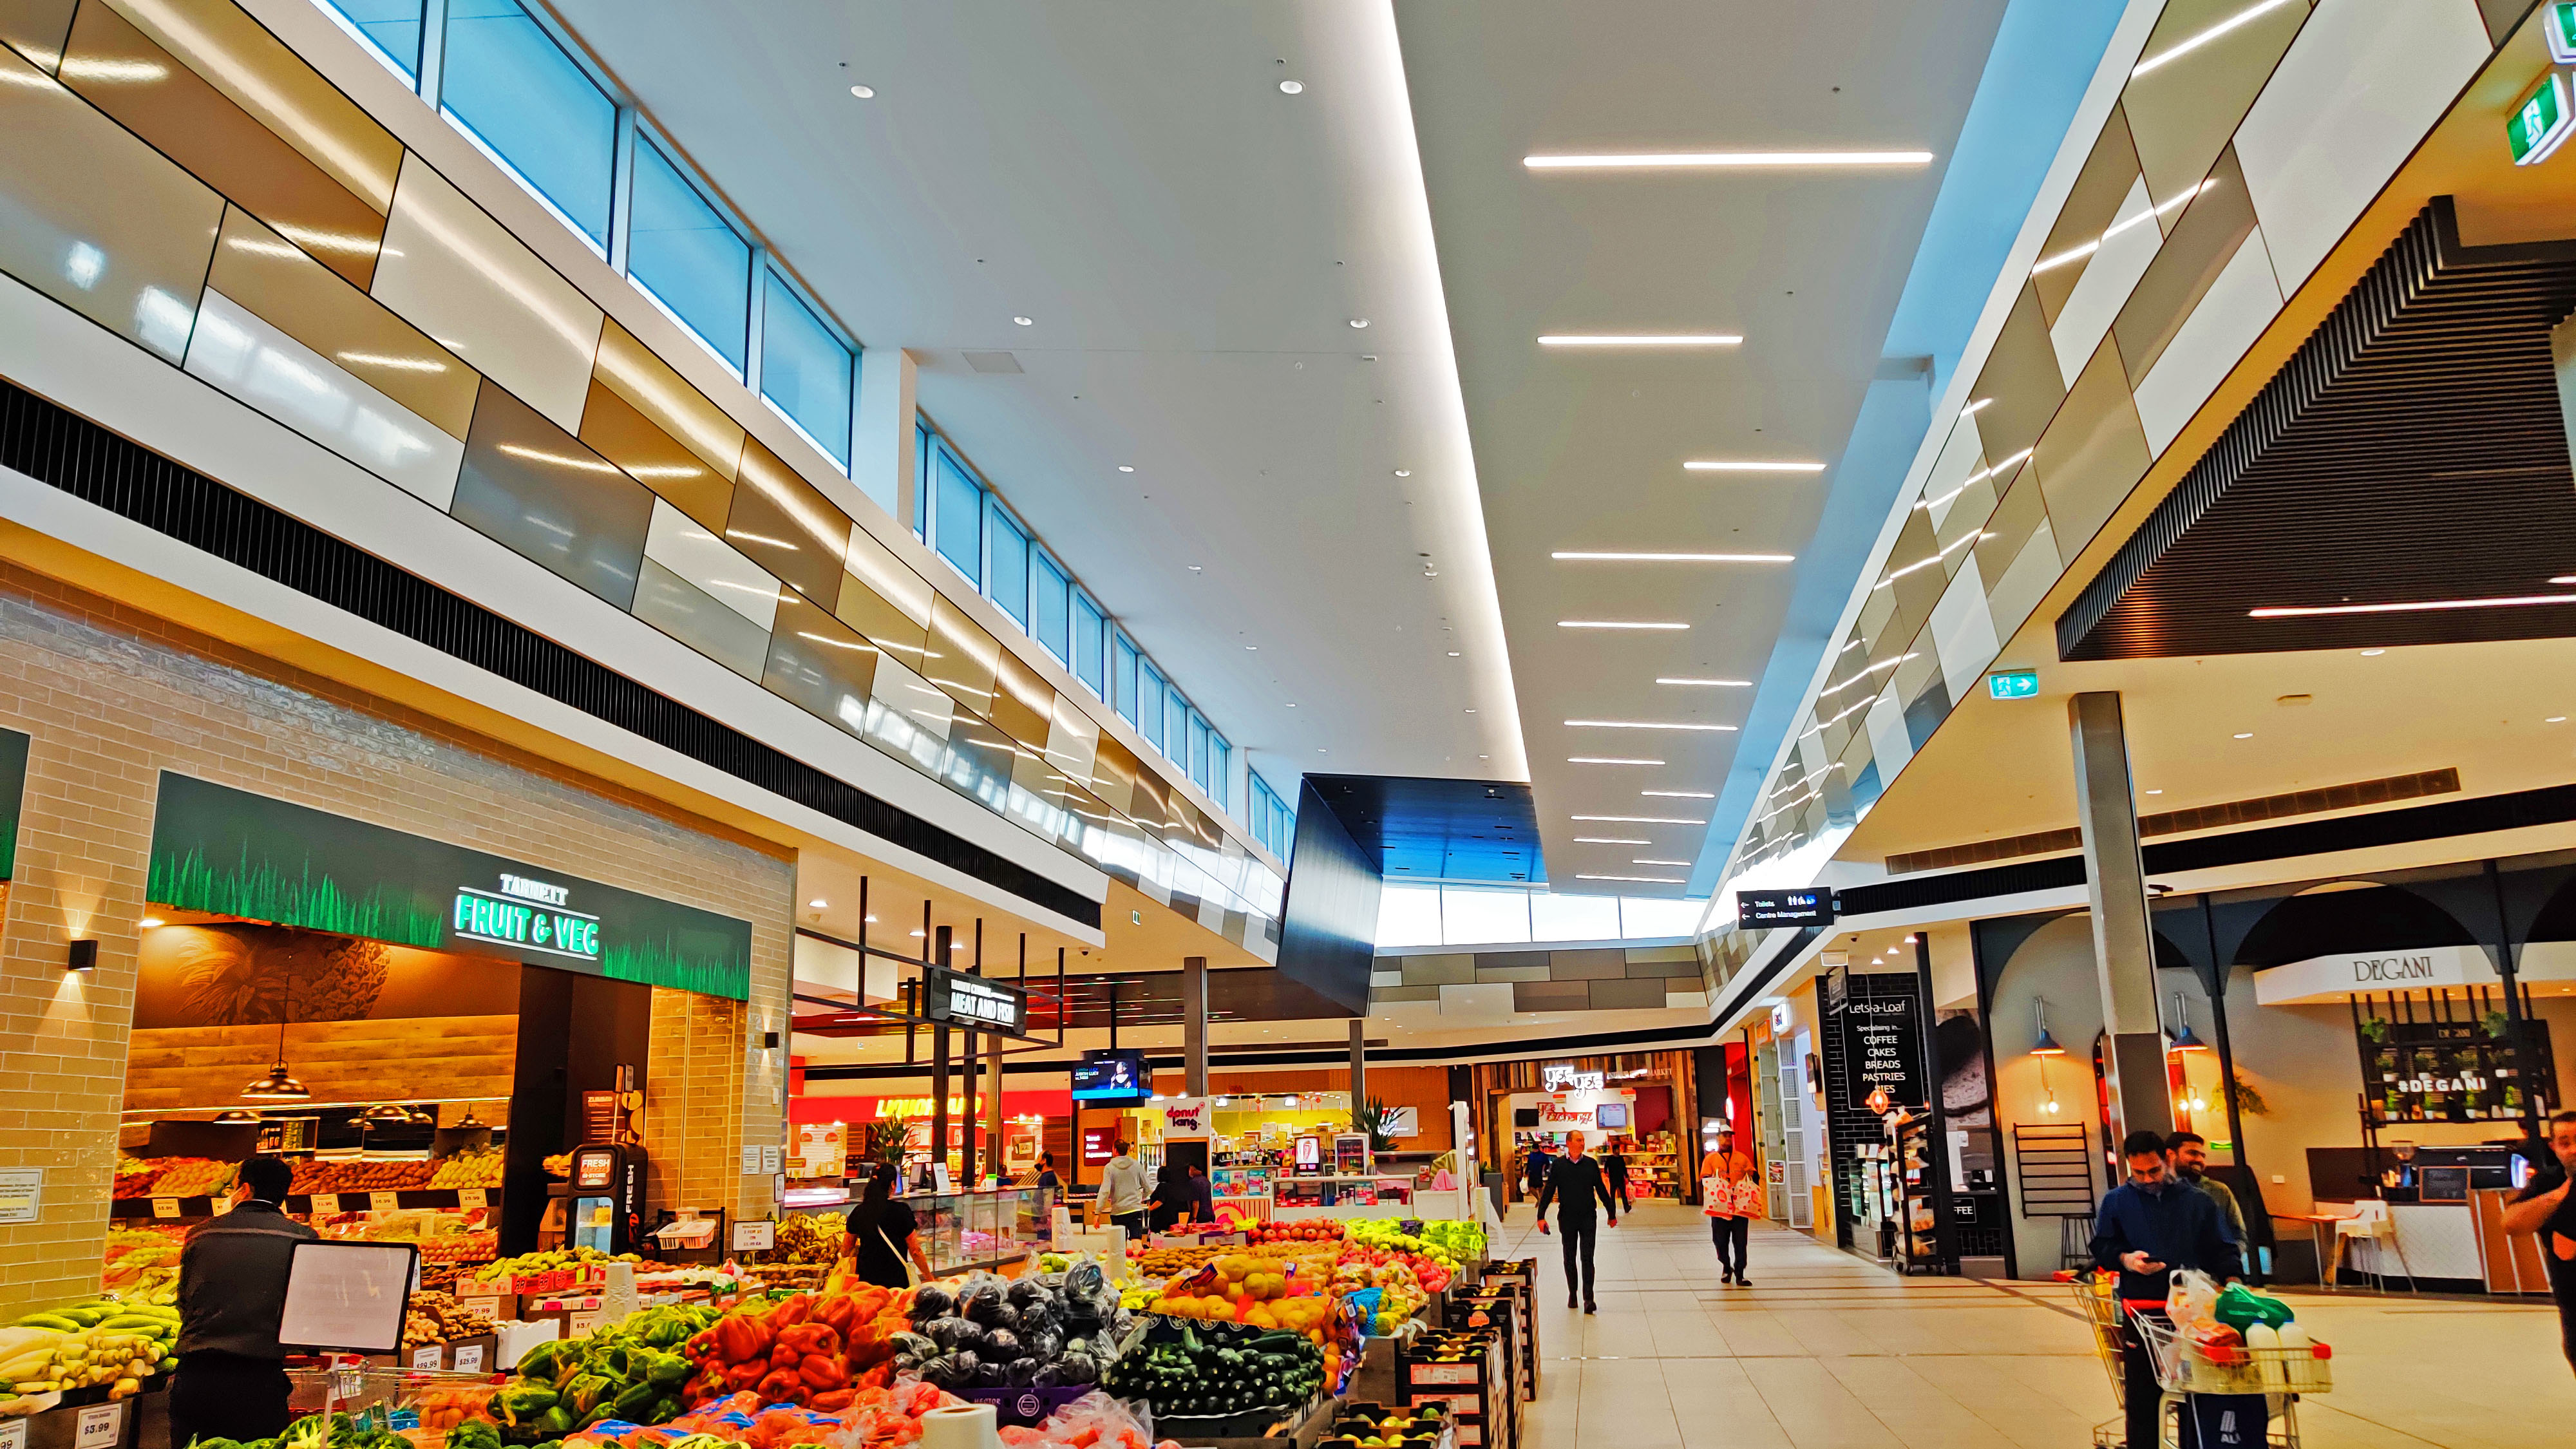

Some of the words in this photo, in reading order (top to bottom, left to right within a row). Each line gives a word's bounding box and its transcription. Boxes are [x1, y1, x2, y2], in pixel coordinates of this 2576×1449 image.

[1777, 910, 1817, 918] Management
[454, 895, 532, 942] FRUIT
[532, 913, 553, 943] &
[553, 915, 600, 956] VEG
[2353, 956, 2434, 982] DEGANI
[951, 992, 977, 1016] MEAT
[976, 998, 997, 1019] AND
[996, 1002, 1015, 1023] FISH
[1849, 999, 1906, 1014] Lets-a-Loaf
[1863, 1035, 1899, 1045] COFFEE
[1867, 1047, 1897, 1057] CAKES
[1864, 1060, 1901, 1070] BREADS
[1862, 1072, 1906, 1081] PASTRIES
[2398, 1077, 2488, 1093] #DEGANI
[1166, 1106, 1200, 1118] donut
[625, 1164, 634, 1213] FRESH
[84, 1422, 109, 1435] $3.99
